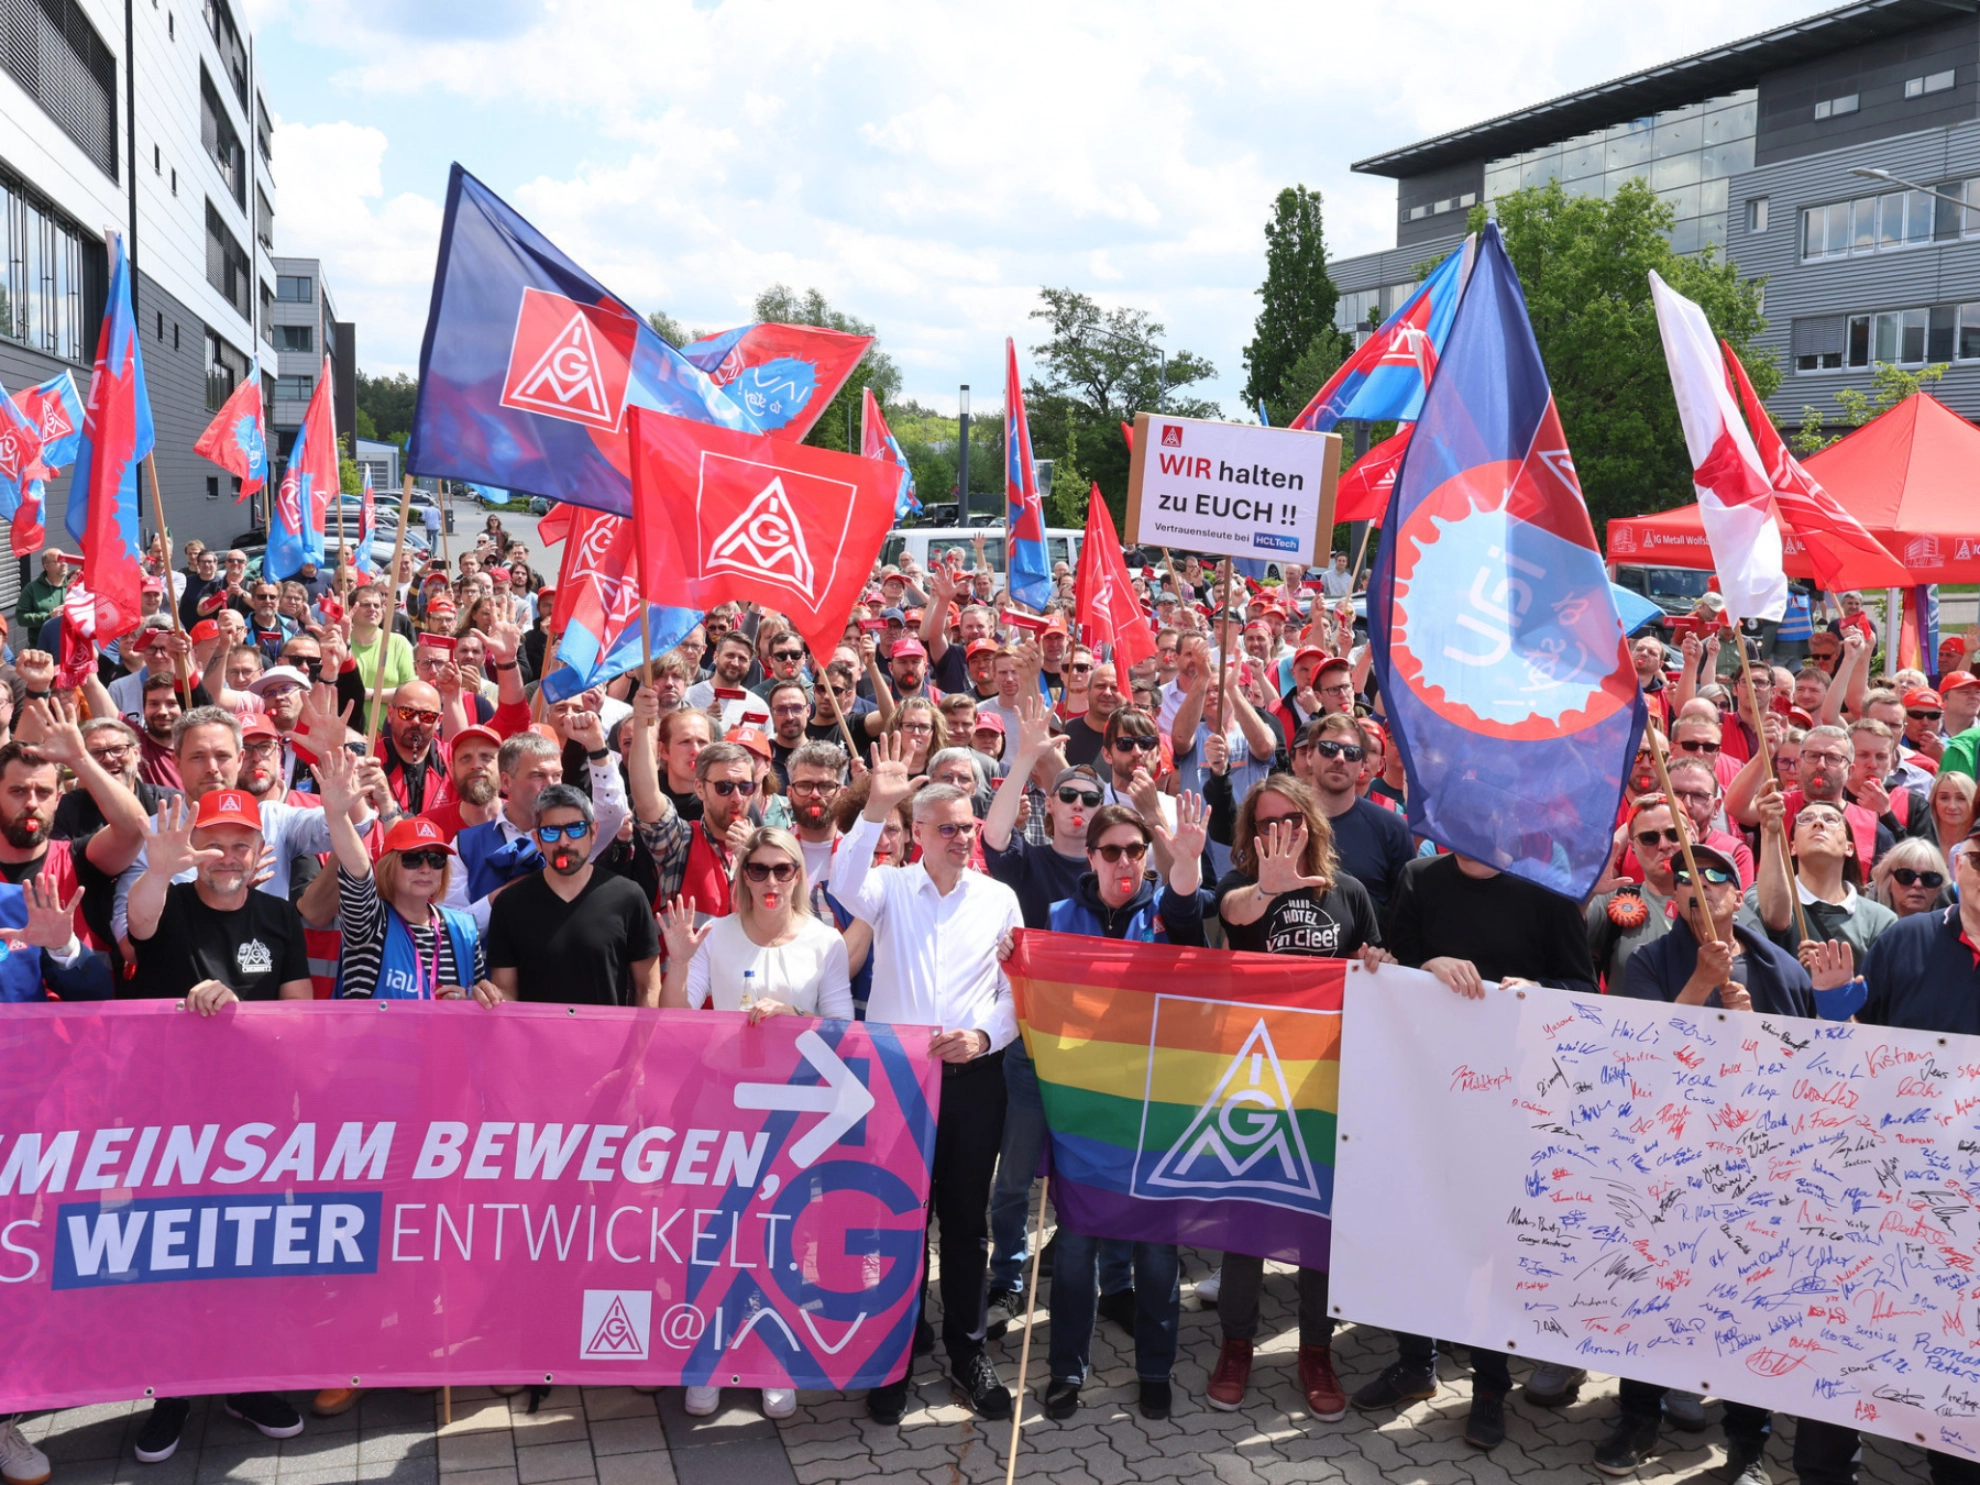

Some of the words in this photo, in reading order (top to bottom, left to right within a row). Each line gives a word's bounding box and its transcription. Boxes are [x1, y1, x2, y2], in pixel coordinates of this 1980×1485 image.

[1159, 453, 1212, 480] WIR
[1219, 460, 1304, 491] halten
[1158, 493, 1188, 513] zu
[1195, 493, 1273, 524] EUCH
[1280, 504, 1297, 526] !!
[1155, 522, 1233, 541] Vertrauensleute
[1234, 532, 1250, 543] bei
[1256, 535, 1297, 549] HCLTech
[1662, 534, 1684, 545] Metall
[1282, 909, 1317, 925] HOTEL
[1294, 923, 1341, 948] Cleef
[0, 1121, 396, 1196] MEINSAM
[412, 1121, 780, 1201] BEWEGEN,
[67, 1203, 366, 1277] WEITER
[391, 1203, 798, 1271] ENTWICKELT.
